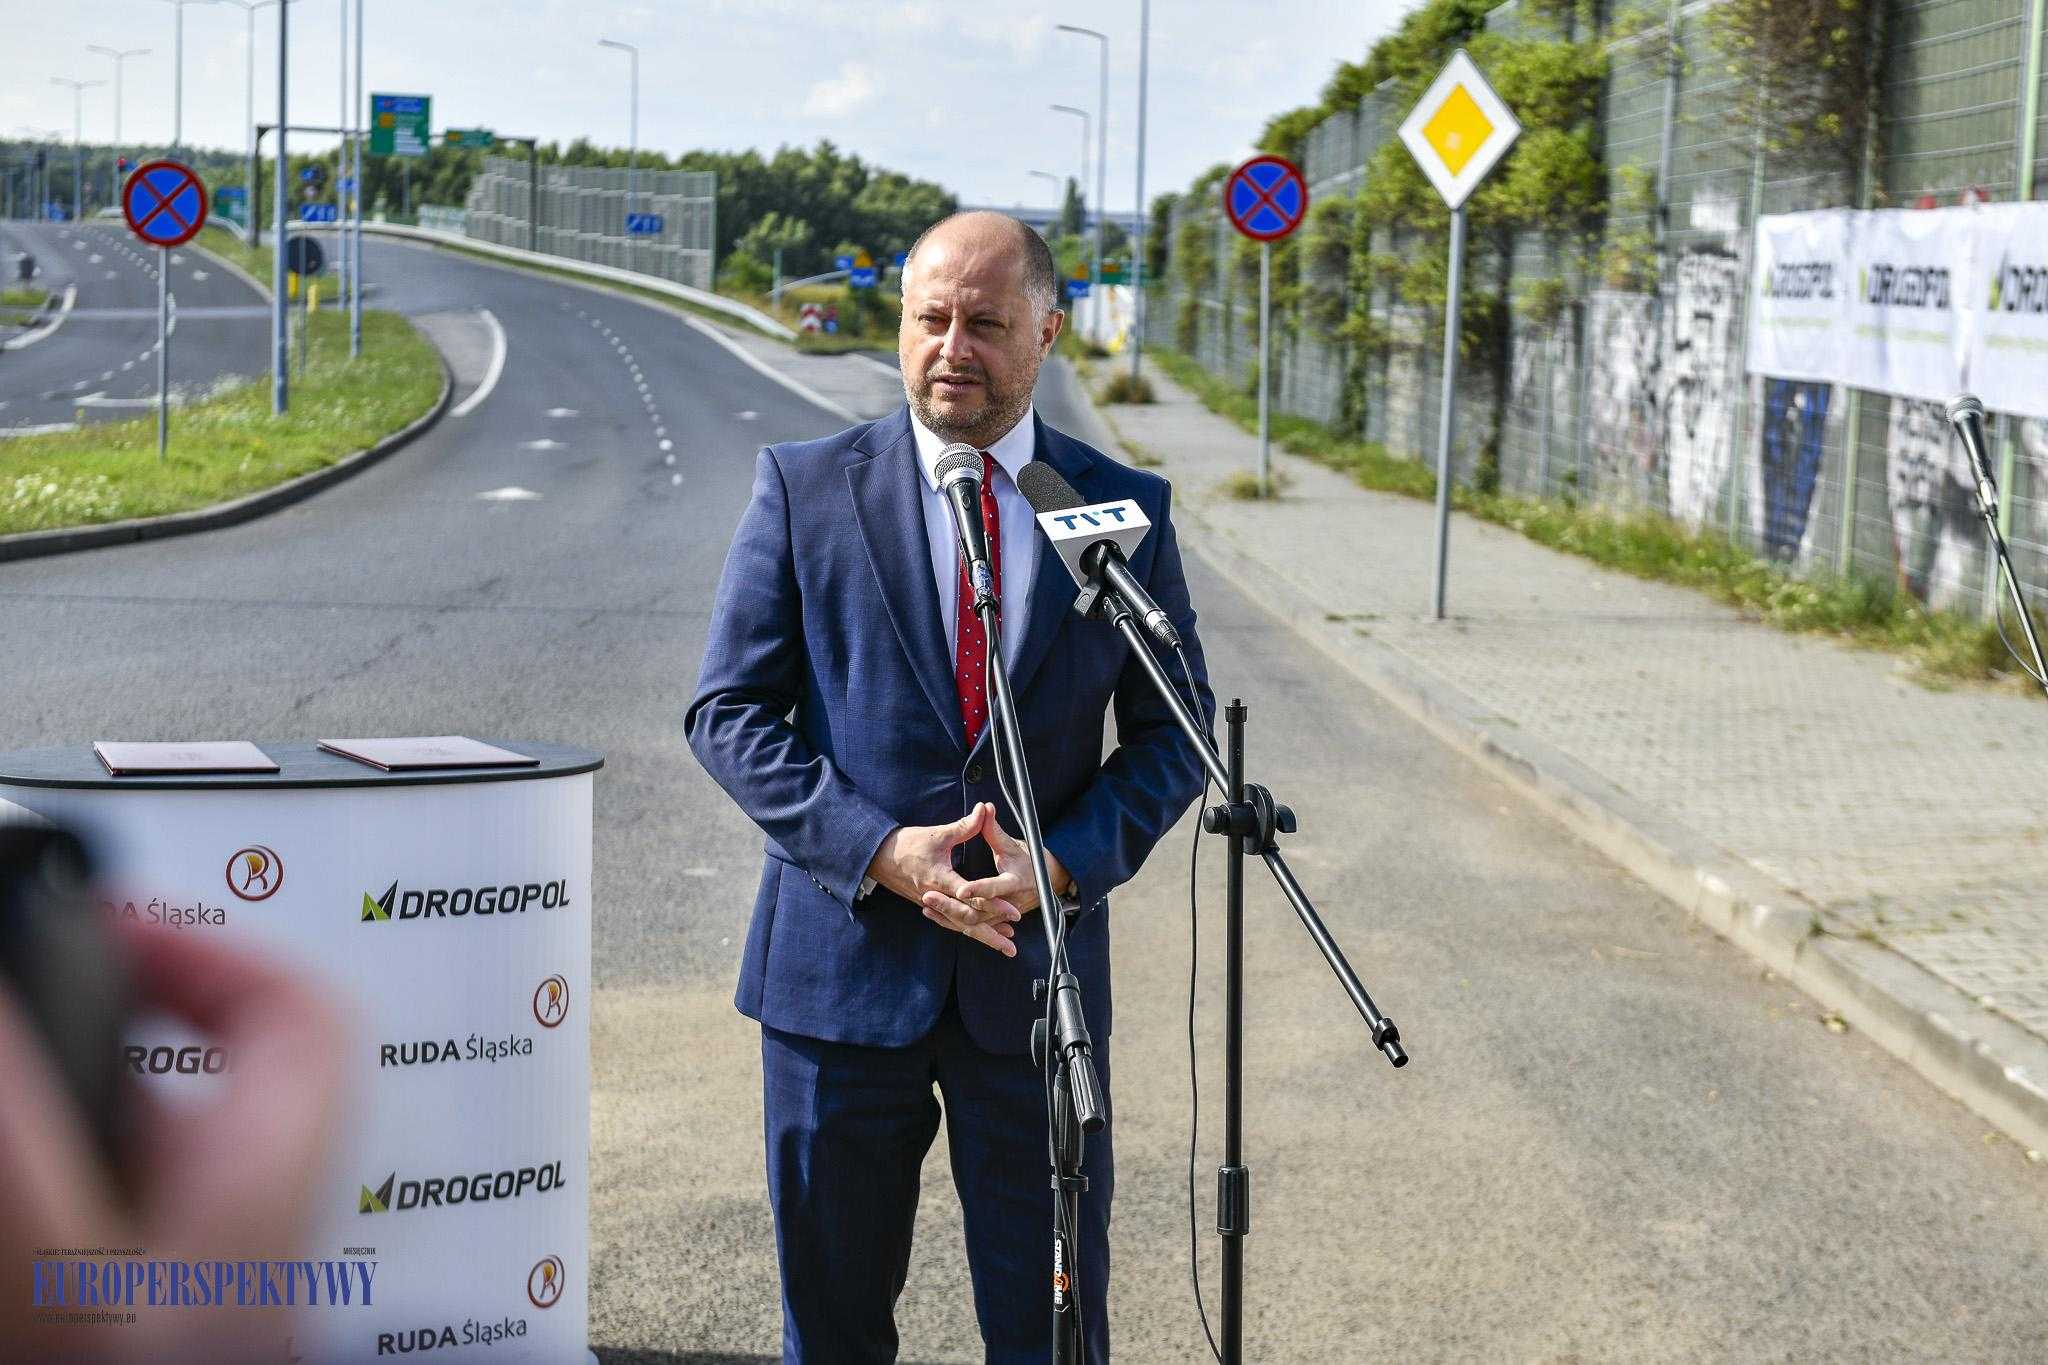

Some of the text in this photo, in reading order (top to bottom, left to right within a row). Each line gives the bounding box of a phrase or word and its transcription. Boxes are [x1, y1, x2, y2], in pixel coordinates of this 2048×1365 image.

[147, 898, 227, 929] Śląska
[399, 879, 570, 919] DROGOPOL
[123, 1046, 229, 1076] ROGO
[380, 1033, 533, 1067] RUDA Śląska
[396, 1160, 567, 1210] DROGOPOL
[377, 1316, 527, 1356] RUDA Śląska
